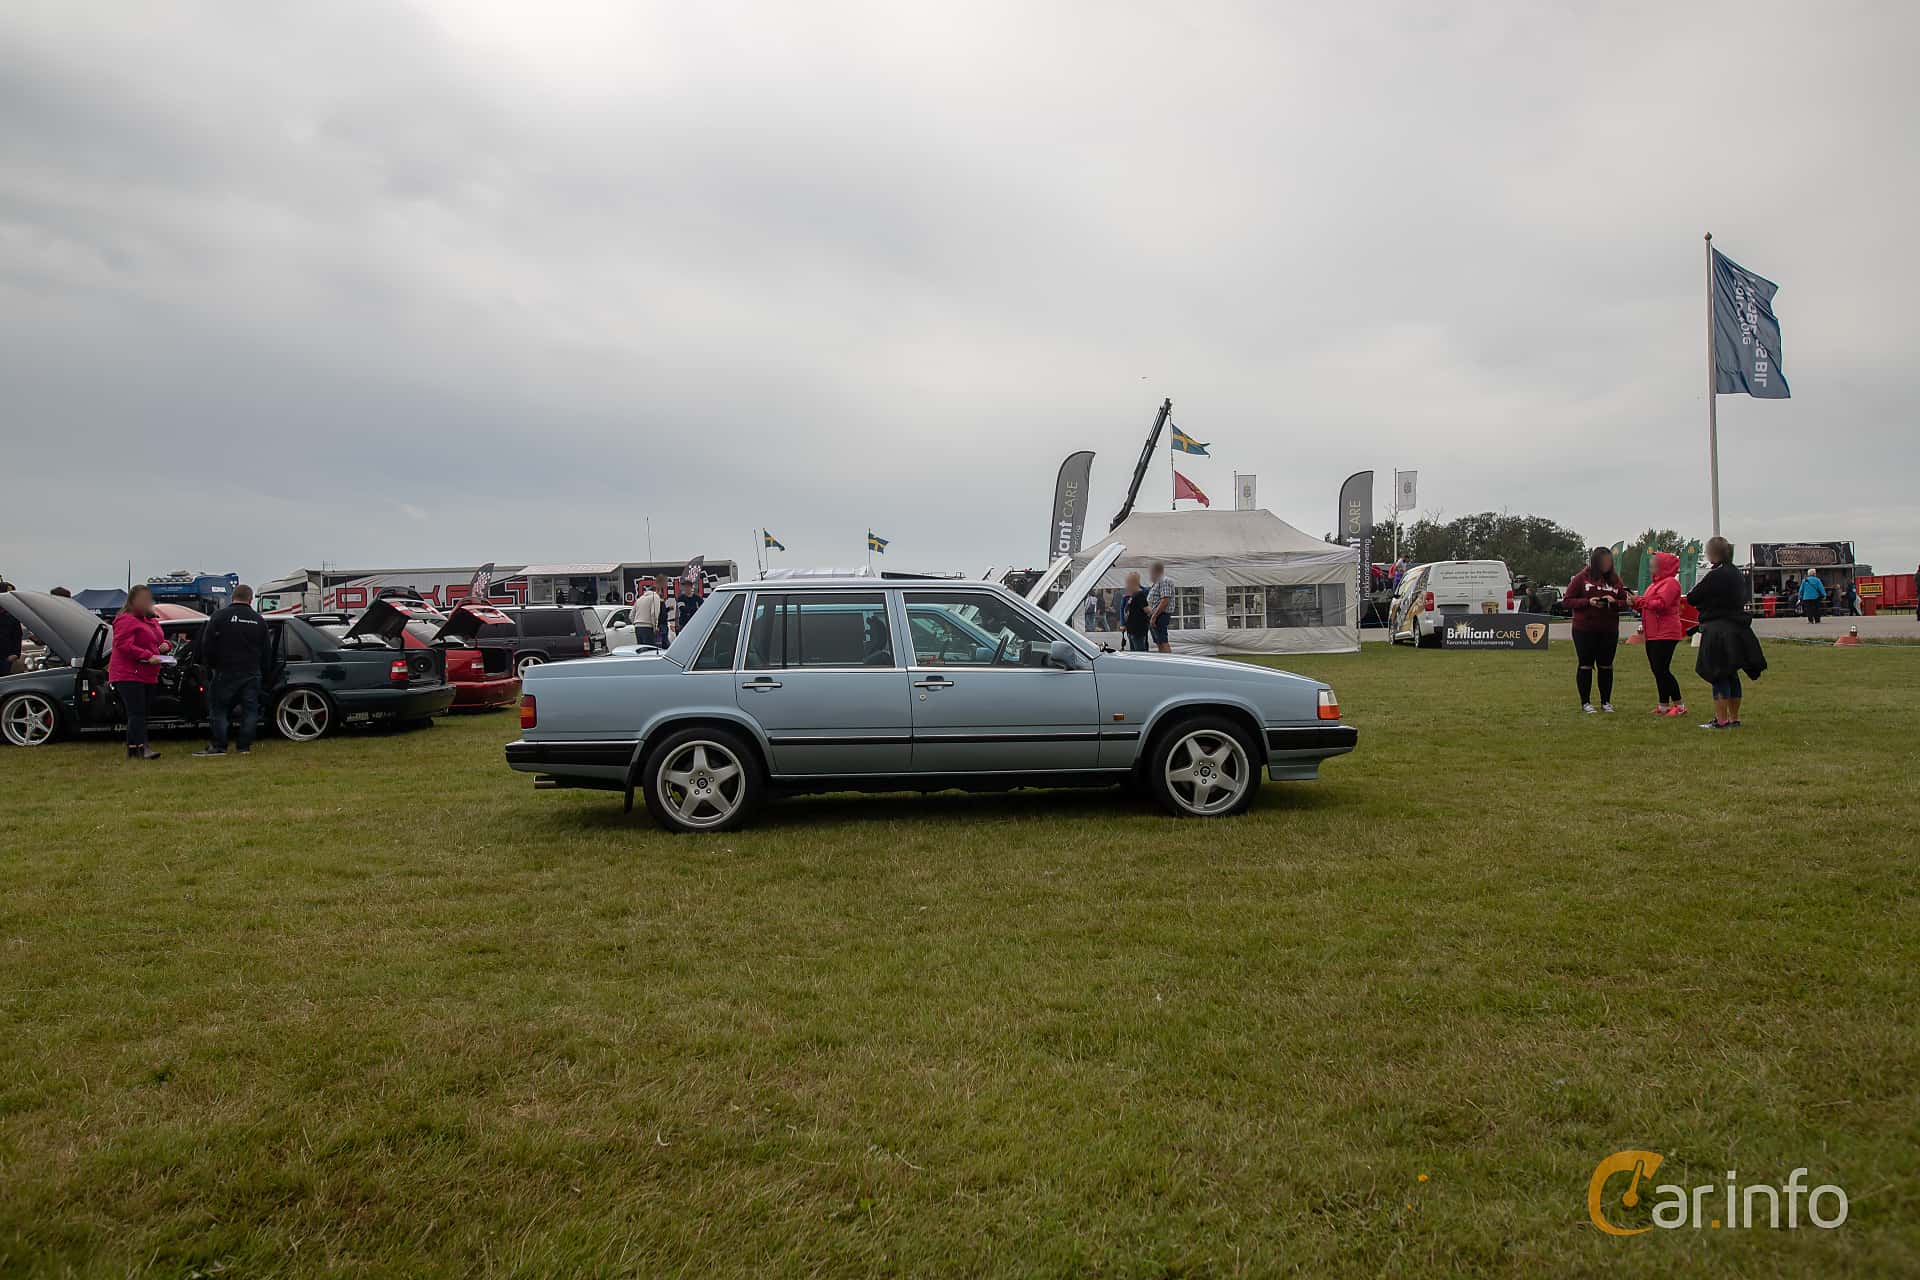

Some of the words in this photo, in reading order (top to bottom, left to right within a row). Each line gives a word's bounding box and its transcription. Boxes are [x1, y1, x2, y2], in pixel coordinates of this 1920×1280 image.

[1064, 480, 1078, 518] CARE
[1349, 499, 1361, 534] CARE
[1447, 626, 1495, 639] Brilliant
[1496, 630, 1521, 639] CARE
